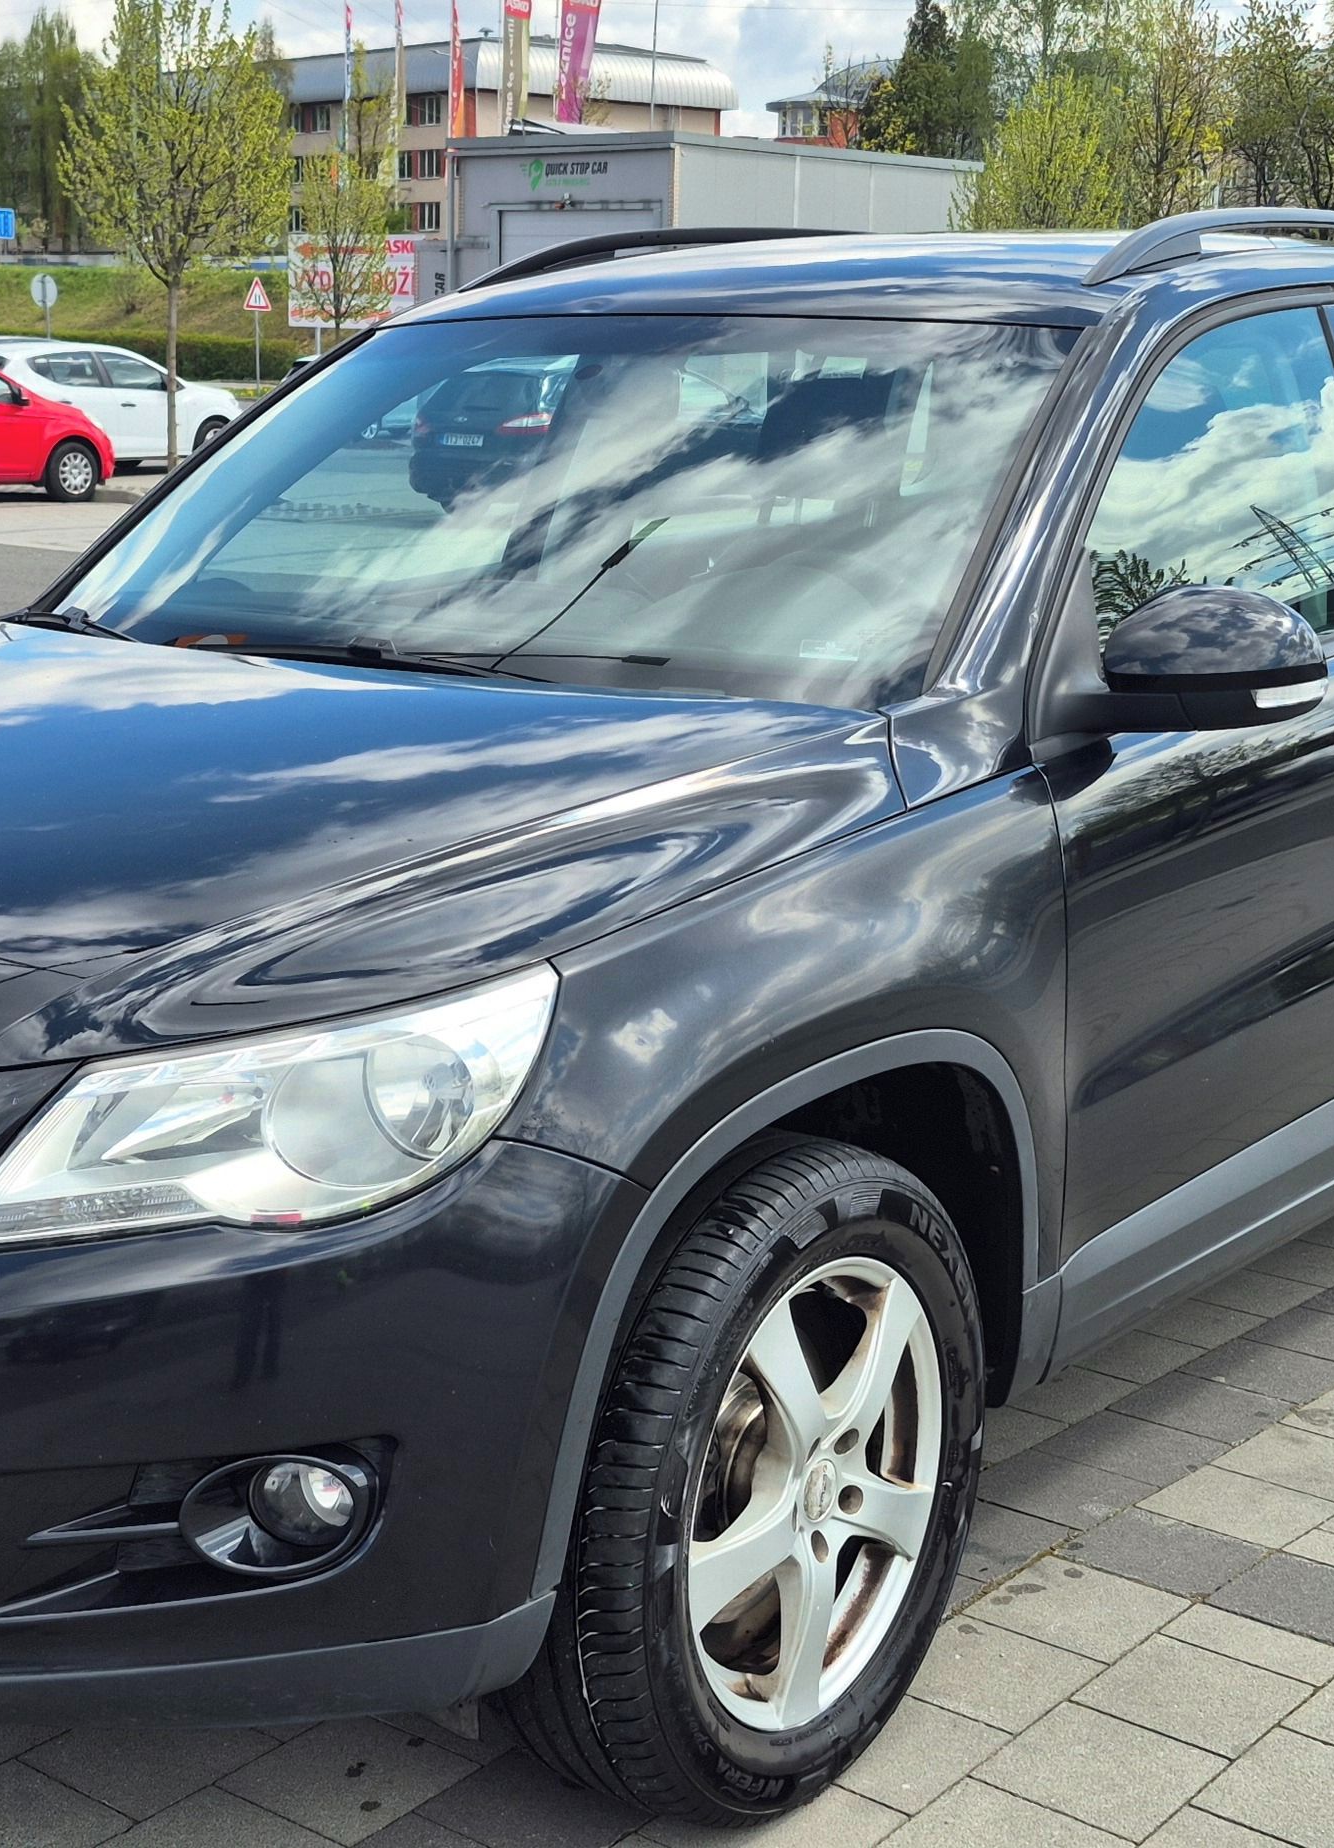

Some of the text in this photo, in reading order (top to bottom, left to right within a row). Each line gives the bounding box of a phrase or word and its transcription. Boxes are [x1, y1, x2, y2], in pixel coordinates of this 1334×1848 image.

[545, 161, 609, 178] QUICK STOP CAR
